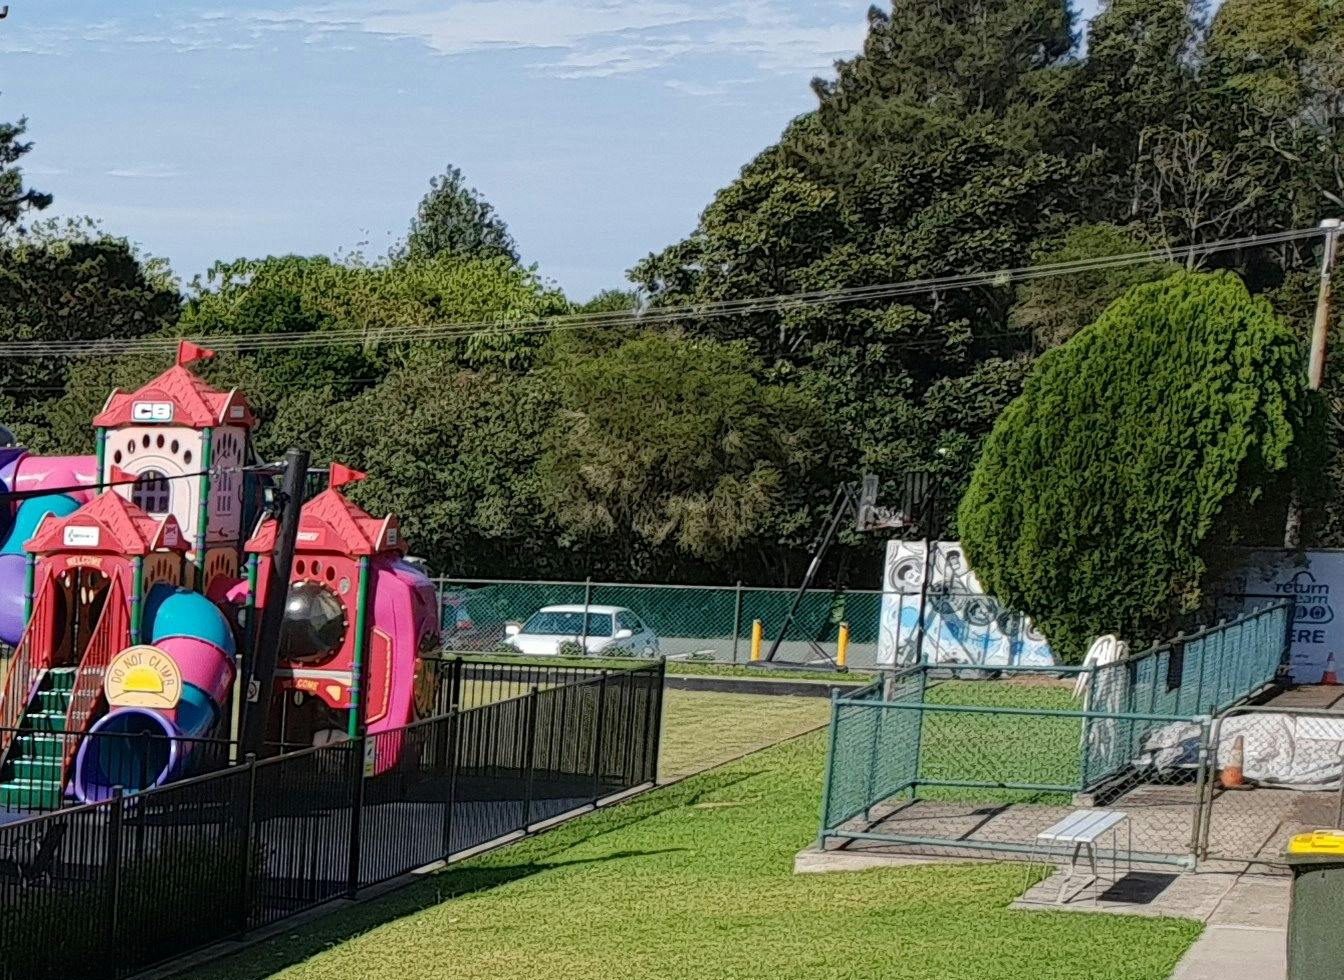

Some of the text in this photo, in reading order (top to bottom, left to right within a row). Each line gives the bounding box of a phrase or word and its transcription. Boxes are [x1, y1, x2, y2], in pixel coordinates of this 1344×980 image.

[66, 556, 104, 567] WELCOME
[1275, 581, 1330, 594] return
[110, 668, 125, 684] DO
[123, 653, 143, 669] NOT
